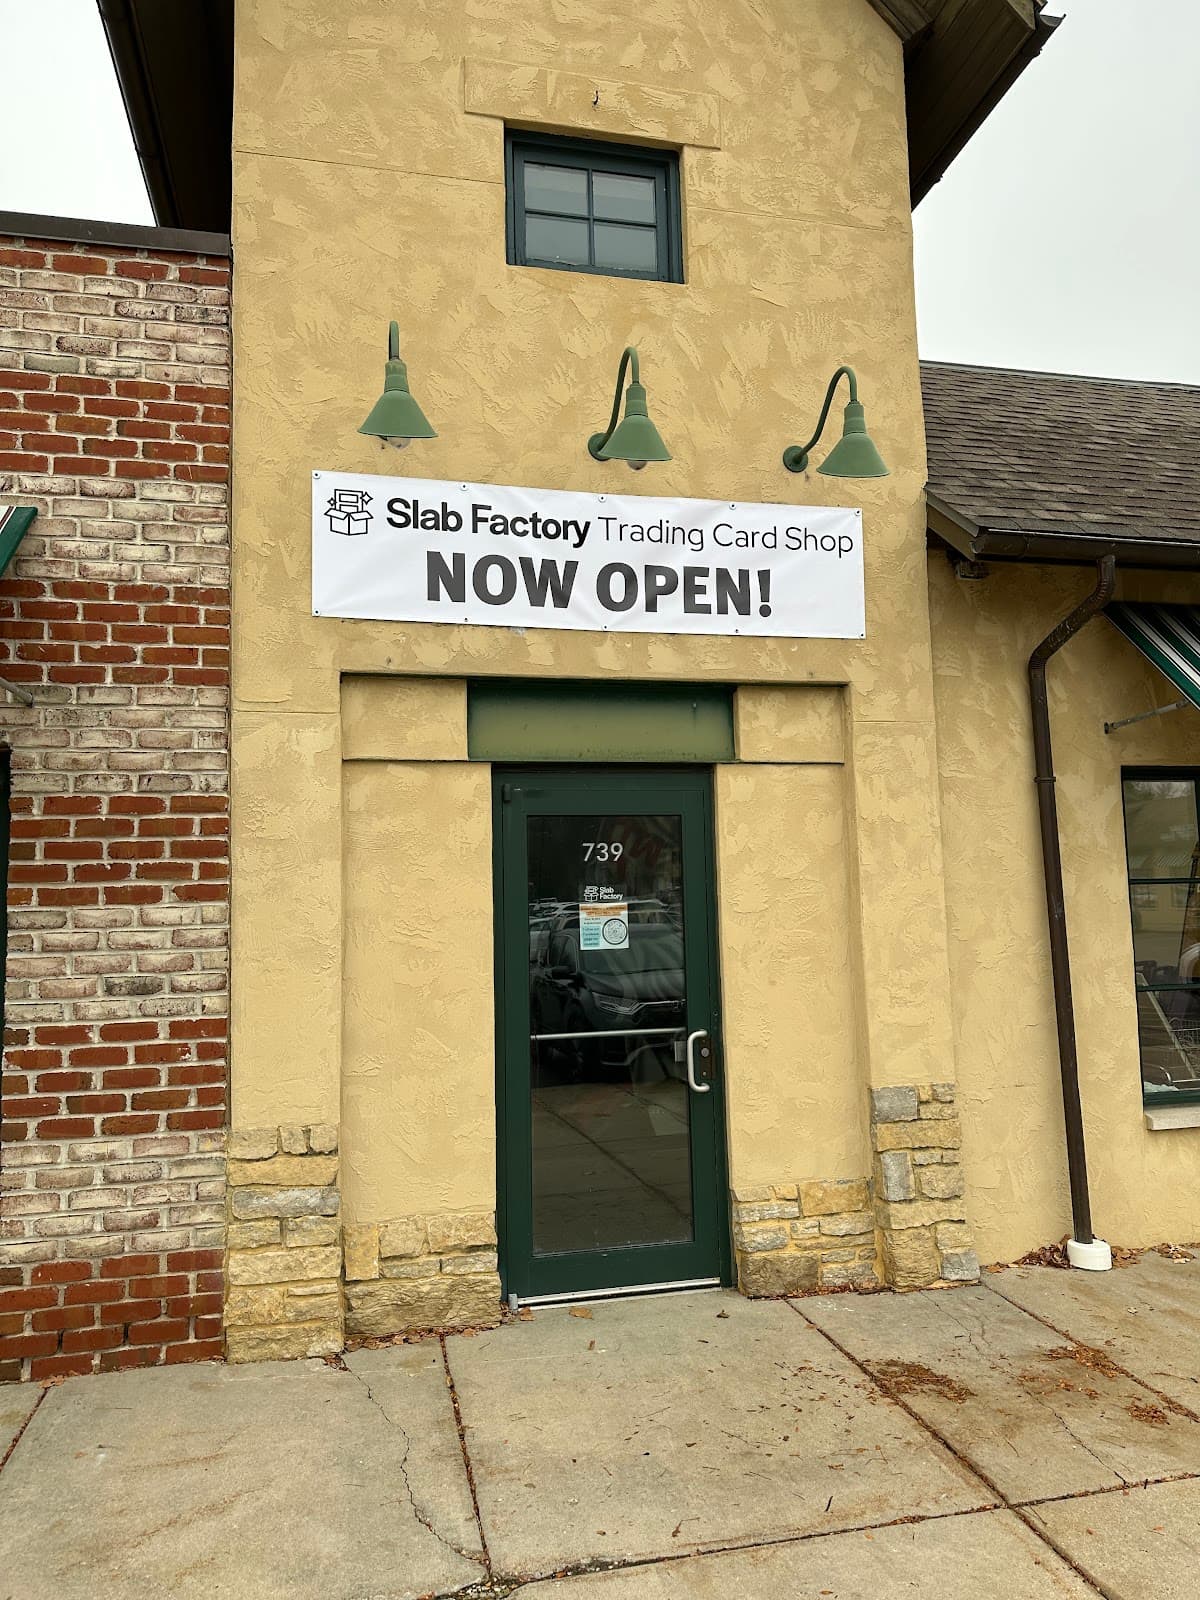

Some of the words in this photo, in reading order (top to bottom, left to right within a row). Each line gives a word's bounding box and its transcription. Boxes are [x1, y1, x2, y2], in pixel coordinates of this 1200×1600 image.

[387, 498, 463, 532] Slab
[471, 503, 591, 548] Factory
[598, 516, 704, 552] Trading
[713, 523, 777, 550] Card
[785, 527, 854, 558] Shop
[426, 550, 579, 608] NOW
[596, 562, 772, 617] OPEN!
[582, 842, 624, 862] 739
[599, 893, 624, 901] Factory
